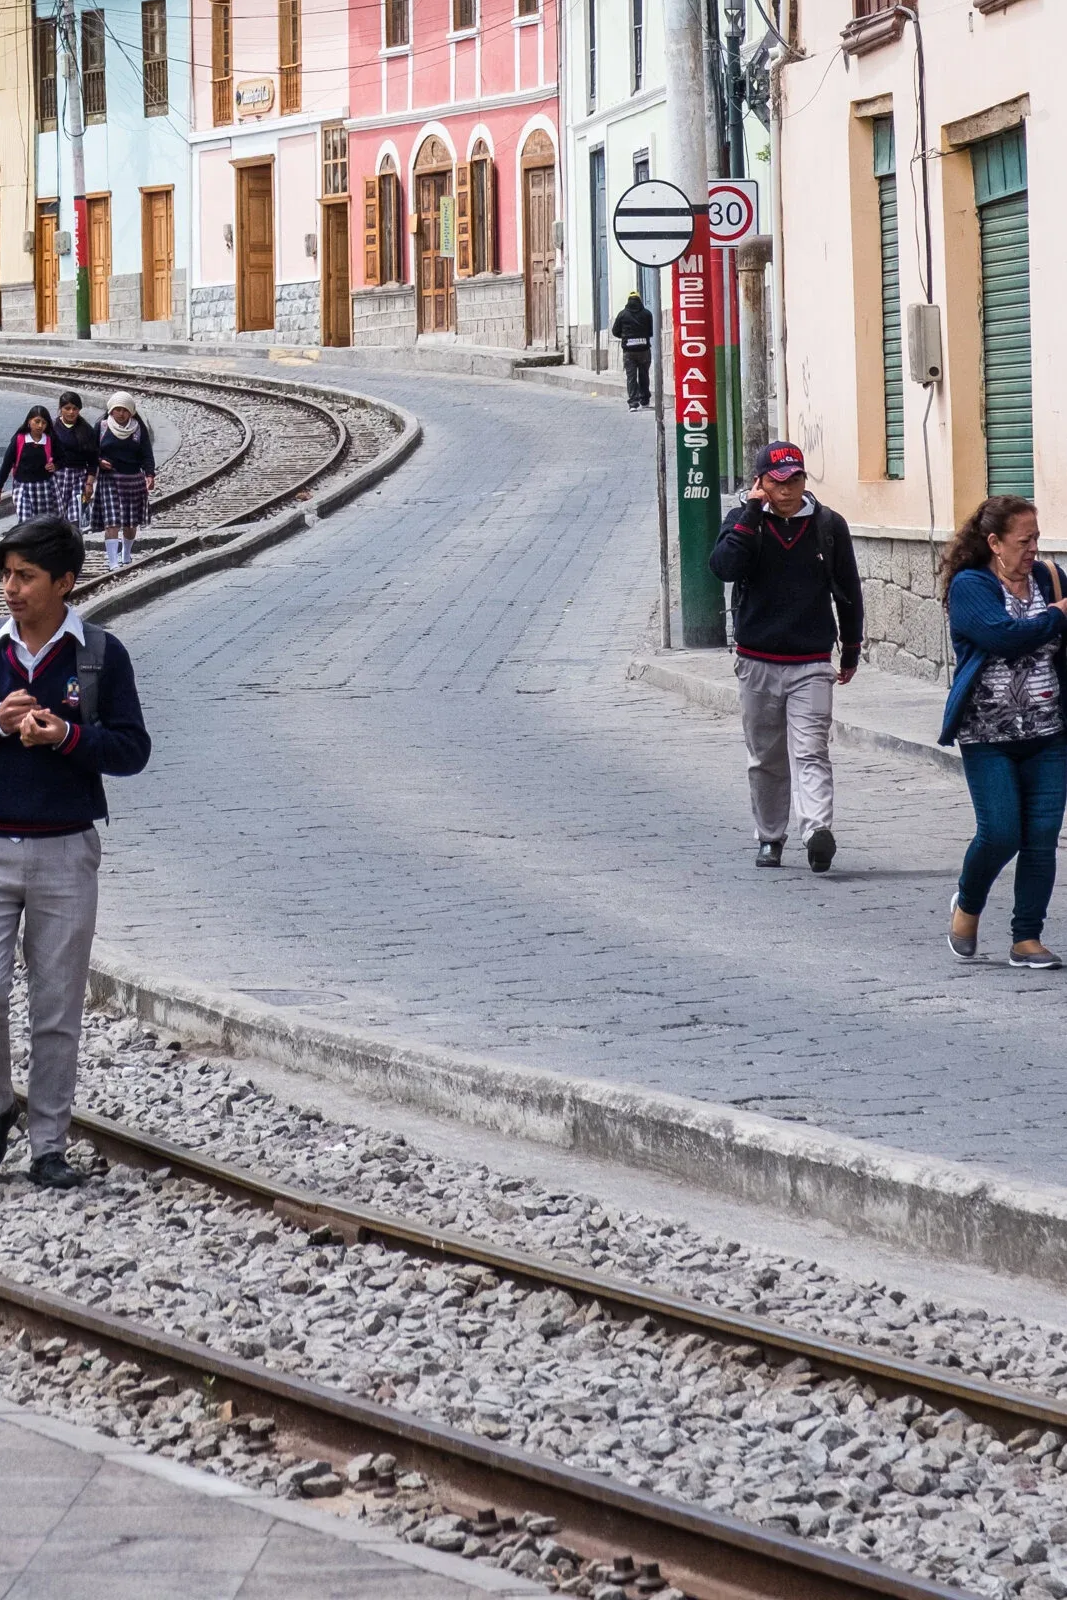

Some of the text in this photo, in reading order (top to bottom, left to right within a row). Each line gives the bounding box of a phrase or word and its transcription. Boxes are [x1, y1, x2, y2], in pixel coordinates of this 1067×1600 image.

[709, 201, 743, 226] 30
[678, 254, 704, 274] MI
[678, 276, 707, 357] BELLO
[687, 467, 704, 485] te
[683, 486, 710, 499] amo
